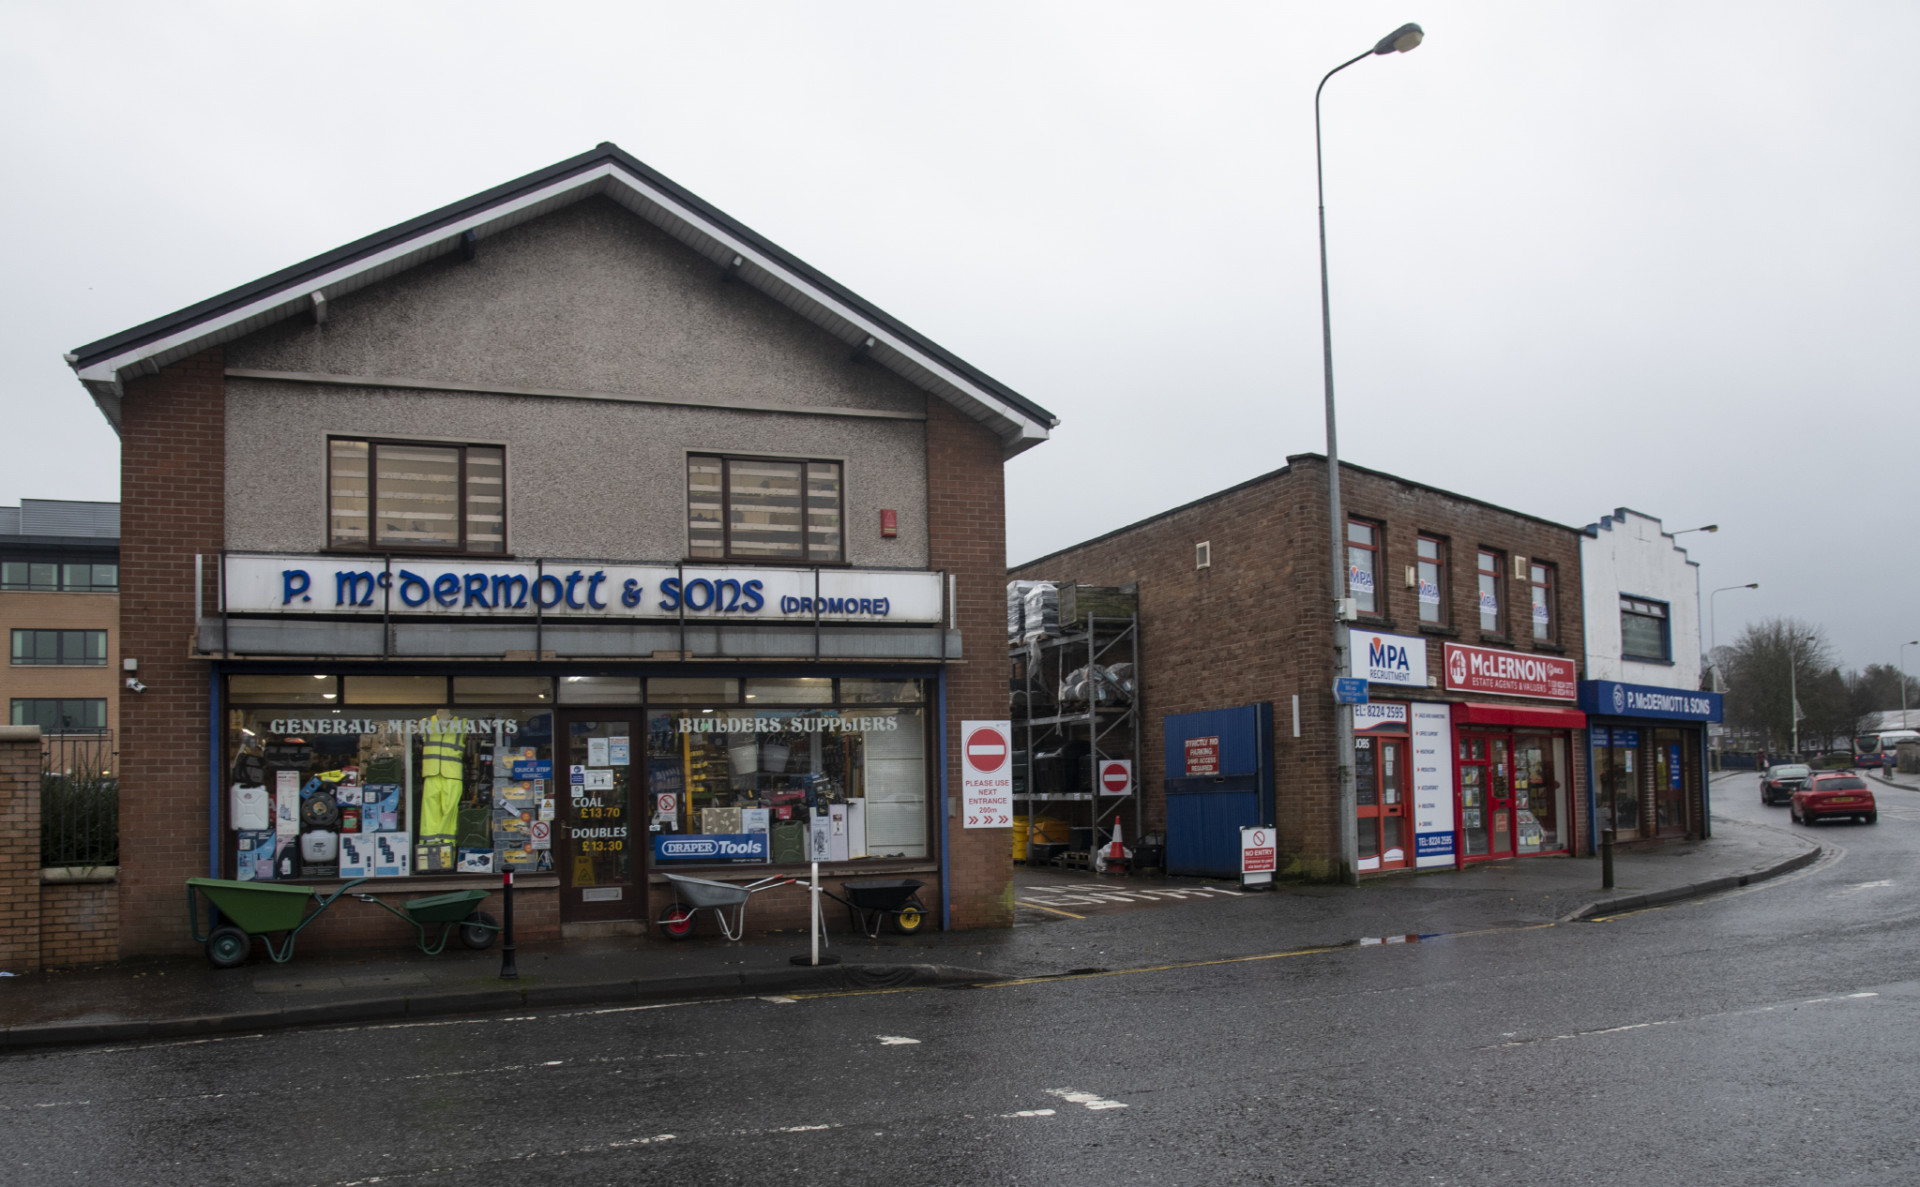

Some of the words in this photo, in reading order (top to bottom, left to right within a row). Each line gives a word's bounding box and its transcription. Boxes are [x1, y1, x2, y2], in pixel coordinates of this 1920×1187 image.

[1350, 567, 1373, 586] MPA
[282, 569, 311, 606] P.
[621, 578, 643, 608] &
[780, 595, 890, 616] (DROMORE)
[1419, 580, 1439, 598] MPA
[1369, 638, 1410, 671] MPA
[1470, 652, 1547, 683] McLERNON
[1369, 669, 1411, 681] RECRUITMENT
[1472, 676, 1494, 688] ESTATE
[1495, 679, 1518, 690] AGENTS
[1523, 683, 1547, 693] VALUERS
[1353, 704, 1366, 717] EL:
[1367, 705, 1385, 717] 8224
[1386, 706, 1404, 719] 2595
[1683, 697, 1690, 713] &
[1690, 697, 1711, 715] SONS
[270, 718, 378, 735] GENERAL
[386, 718, 518, 735] MERCHANTS
[678, 717, 782, 734] BUILDERS
[790, 716, 898, 733] SUPPLIERS
[1185, 738, 1208, 747] STRICTLY
[1209, 737, 1218, 745] NO
[1355, 737, 1370, 749] JOBS
[1190, 747, 1213, 755] PARKING
[1199, 756, 1217, 764] ACCESS
[1191, 764, 1213, 772] REQUIRED
[995, 779, 1009, 787] USE
[572, 797, 605, 808] COAL
[968, 797, 1007, 805] ENTRANCE
[581, 807, 621, 819] £13.70
[571, 826, 628, 839] DOUBLES
[582, 840, 623, 852] £13.30
[667, 842, 714, 854] DRAPER
[718, 840, 762, 855] Tools
[1418, 837, 1429, 847] TEL:
[1429, 836, 1441, 846] 8224
[1254, 848, 1273, 856] ENTRY
